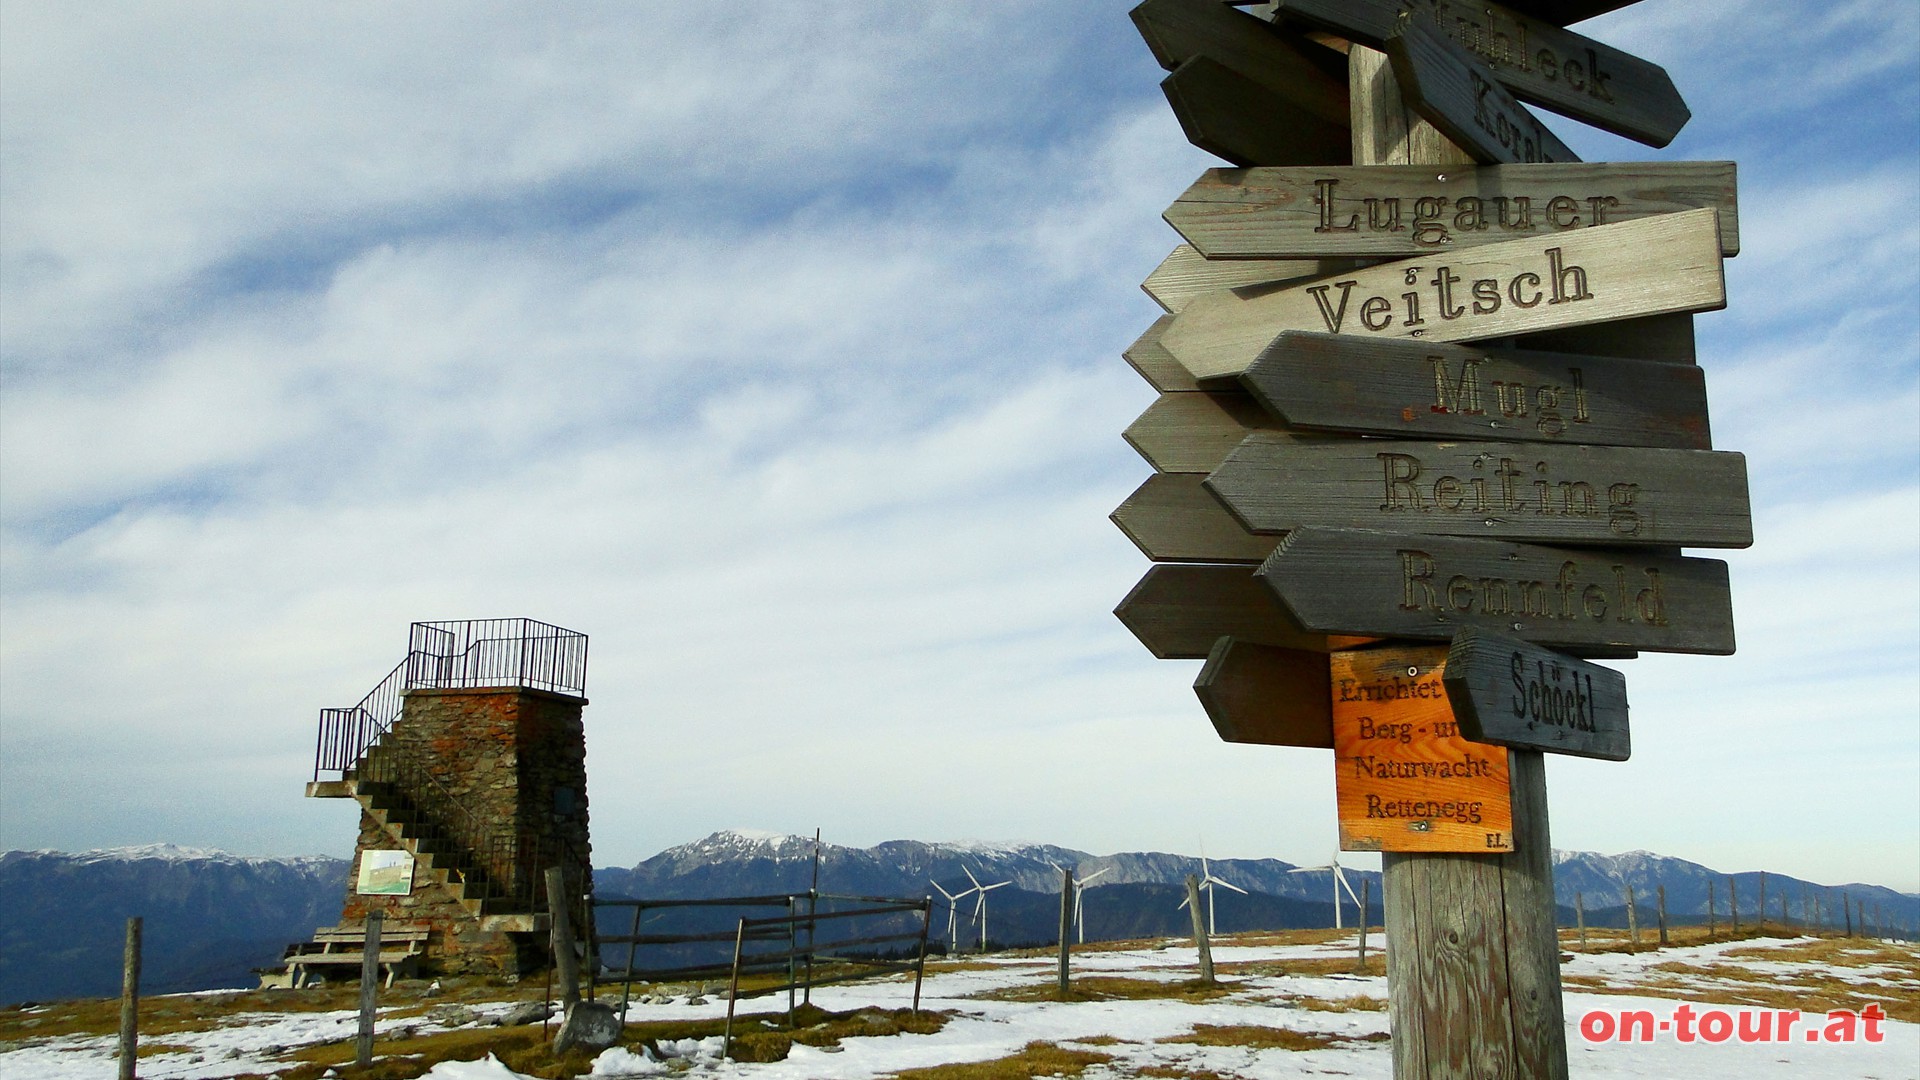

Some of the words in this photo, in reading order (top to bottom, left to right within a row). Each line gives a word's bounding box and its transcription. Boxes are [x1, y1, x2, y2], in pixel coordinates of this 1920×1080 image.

[1403, 0, 1616, 106] tuhleck
[1469, 67, 1554, 163] Koral
[1313, 178, 1619, 248] Lugauer
[1306, 246, 1594, 334] Veitsch
[1426, 354, 1592, 437] Mugl
[1376, 452, 1643, 536] Reiting
[1396, 549, 1669, 626] Rennfeld
[1339, 676, 1442, 702] Errichtet
[1511, 651, 1596, 733] Schöckl
[1354, 753, 1493, 779] Naturwacht
[1358, 716, 1413, 744] Berg
[1365, 794, 1483, 824] Rettenegg
